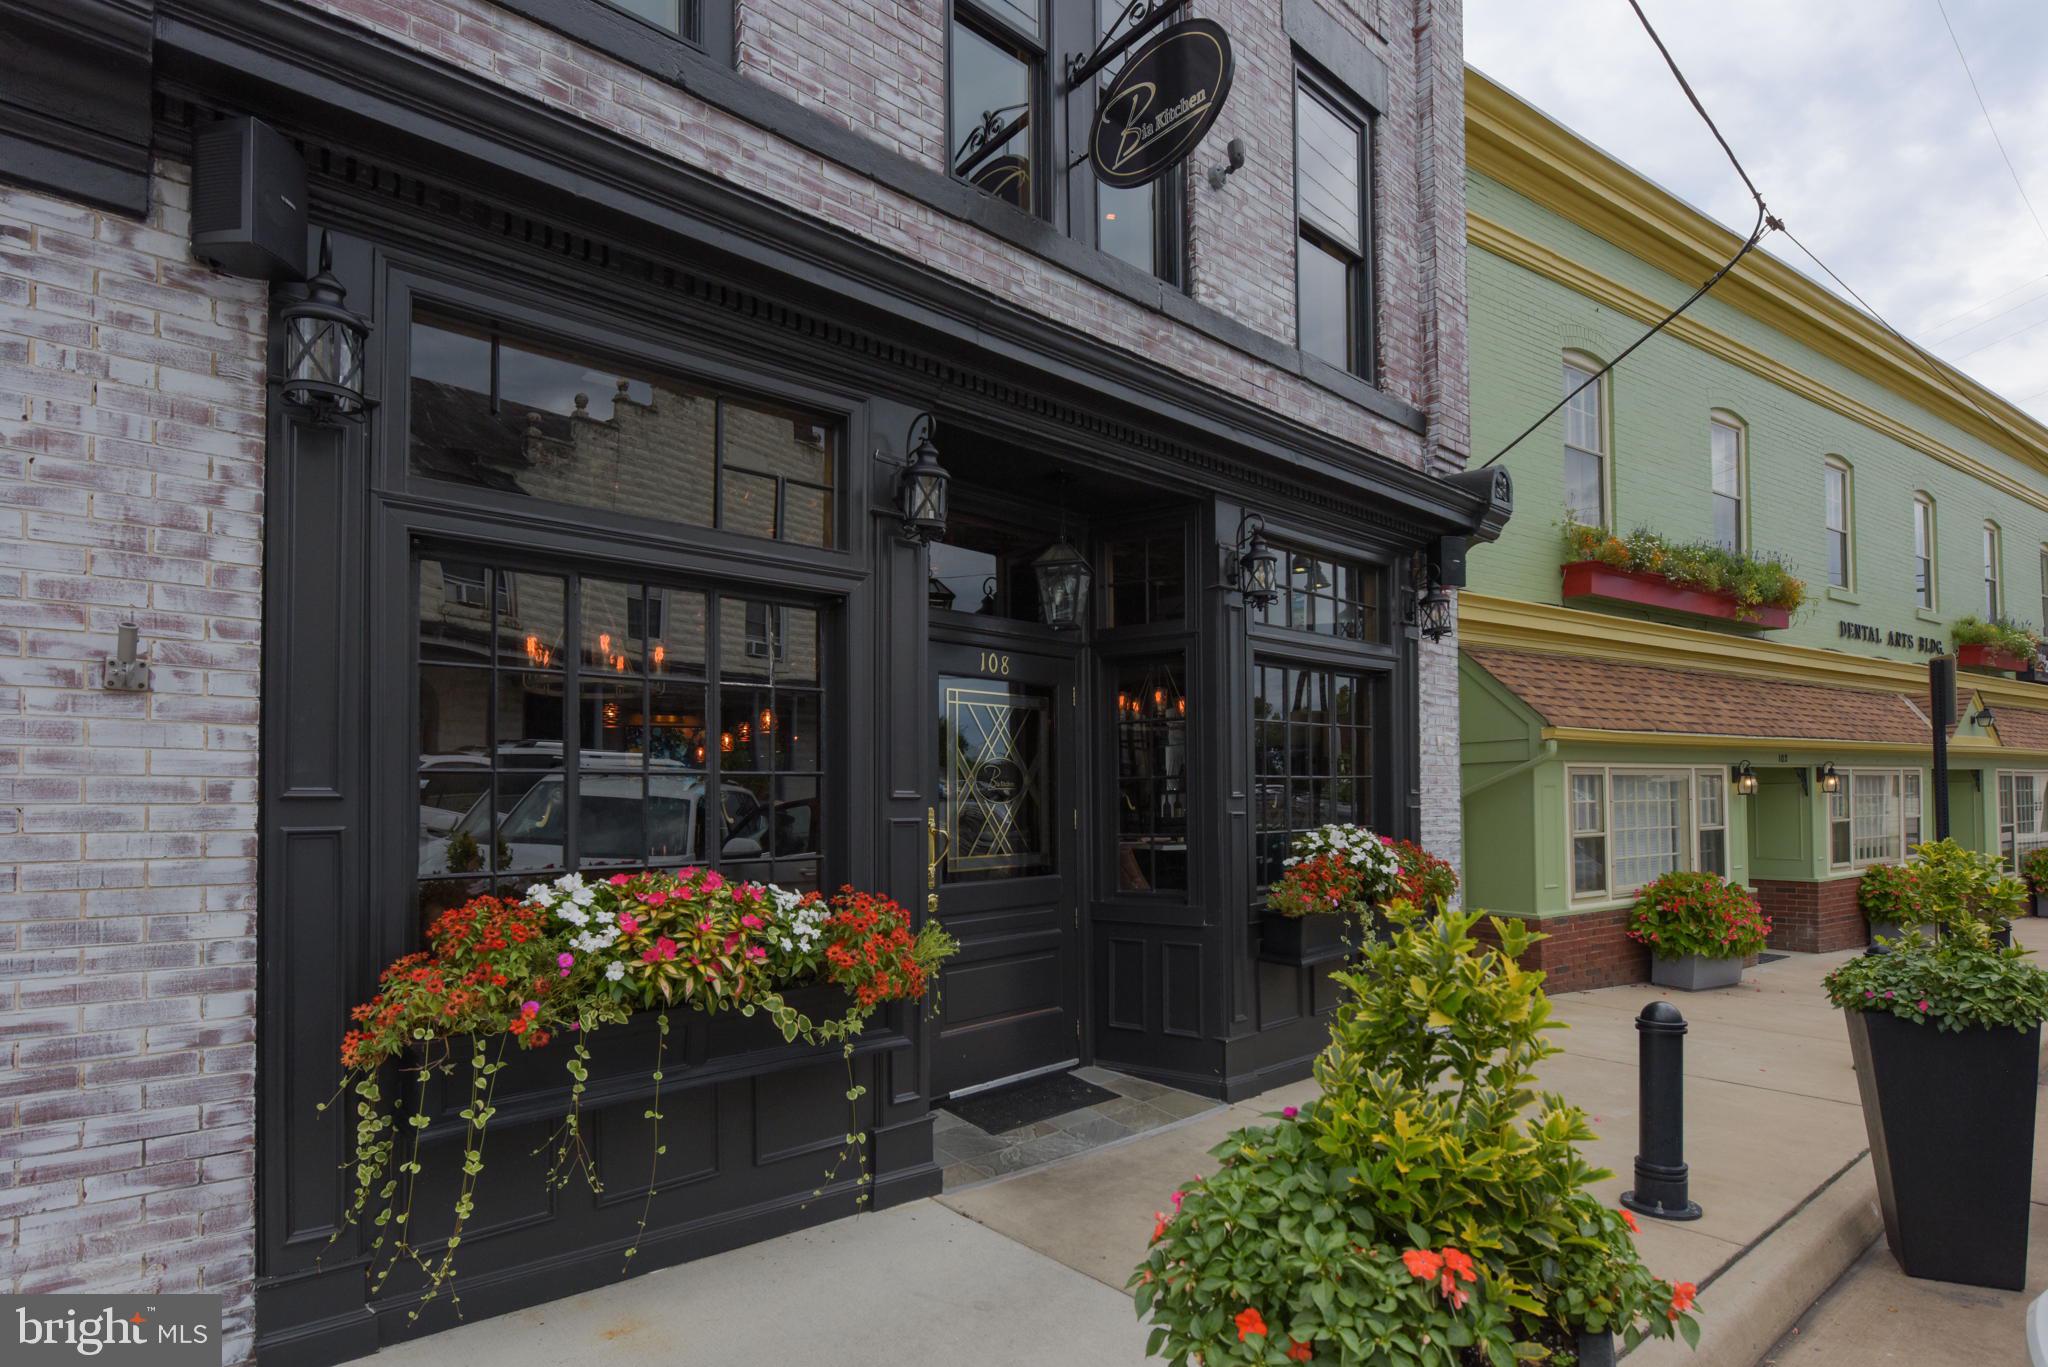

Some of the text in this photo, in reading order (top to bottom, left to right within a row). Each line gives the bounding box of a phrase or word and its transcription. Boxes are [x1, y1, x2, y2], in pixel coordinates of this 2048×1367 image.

[1101, 82, 1207, 170] Bia Kitchen
[1838, 620, 1945, 655] DENTAL ARTS BLDG.
[980, 652, 1009, 675] 108
